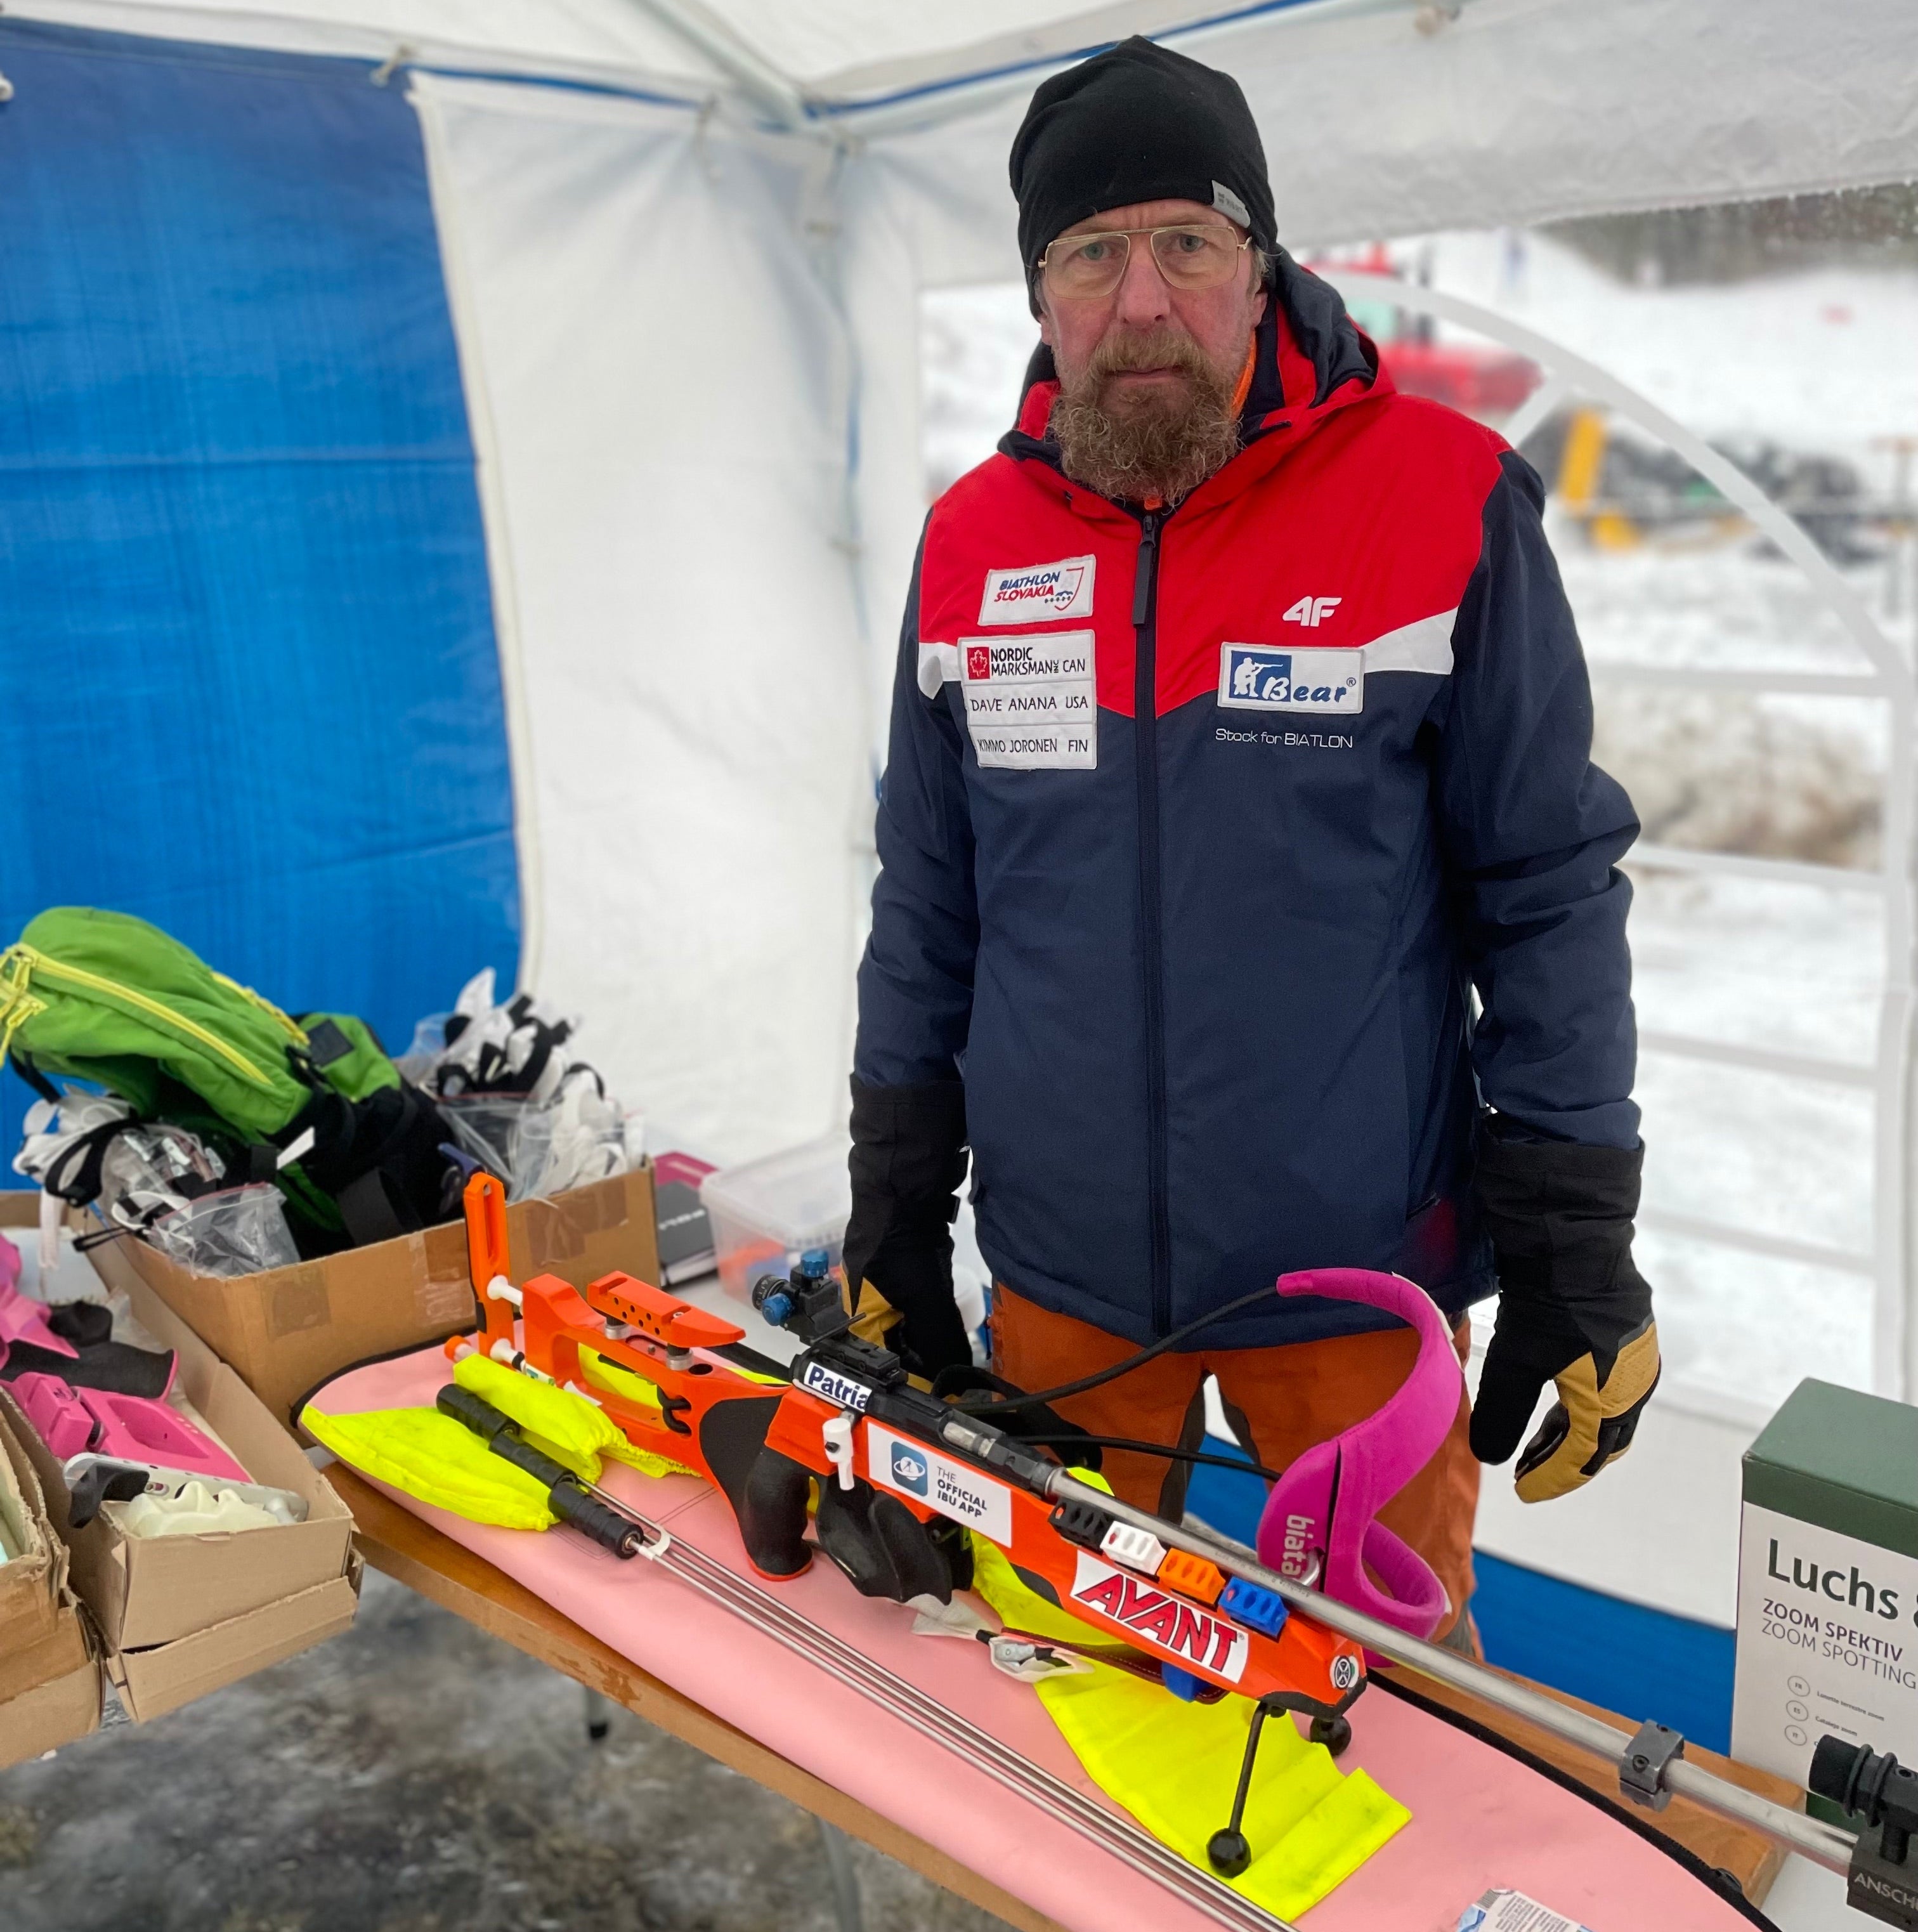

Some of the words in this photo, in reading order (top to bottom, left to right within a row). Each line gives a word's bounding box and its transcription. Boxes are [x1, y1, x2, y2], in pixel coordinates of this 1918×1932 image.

[1000, 571, 1060, 591] BIATHLON
[994, 585, 1054, 602] SLOVAKIA
[1282, 596, 1342, 627] 4F
[991, 647, 1033, 662] NORDIC
[991, 660, 1052, 676] MARKSMAN
[1063, 658, 1085, 673] CAN
[970, 698, 1002, 712] DAVE
[1008, 696, 1057, 710] ANANA
[1066, 696, 1088, 708] USA
[977, 740, 1006, 753] KIMMO
[1010, 739, 1057, 753] JORONEN
[1068, 740, 1088, 753] FIN
[1215, 728, 1258, 743] Stock
[1261, 731, 1282, 745] for
[1284, 733, 1353, 748] BIATLON
[808, 1366, 868, 1409] Patria
[937, 1466, 957, 1484] THE
[937, 1478, 988, 1511] OFFICIAL
[937, 1490, 957, 1507] IBU
[958, 1501, 982, 1518] APP
[1768, 1537, 1899, 1621] Luchs
[1763, 1598, 1819, 1633] ZOOM
[1825, 1621, 1903, 1662] SPEKTIV
[1761, 1617, 1817, 1652] ZOOM
[1822, 1641, 1917, 1690] SPOTTING
[1854, 1872, 1918, 1912] ANSCH
